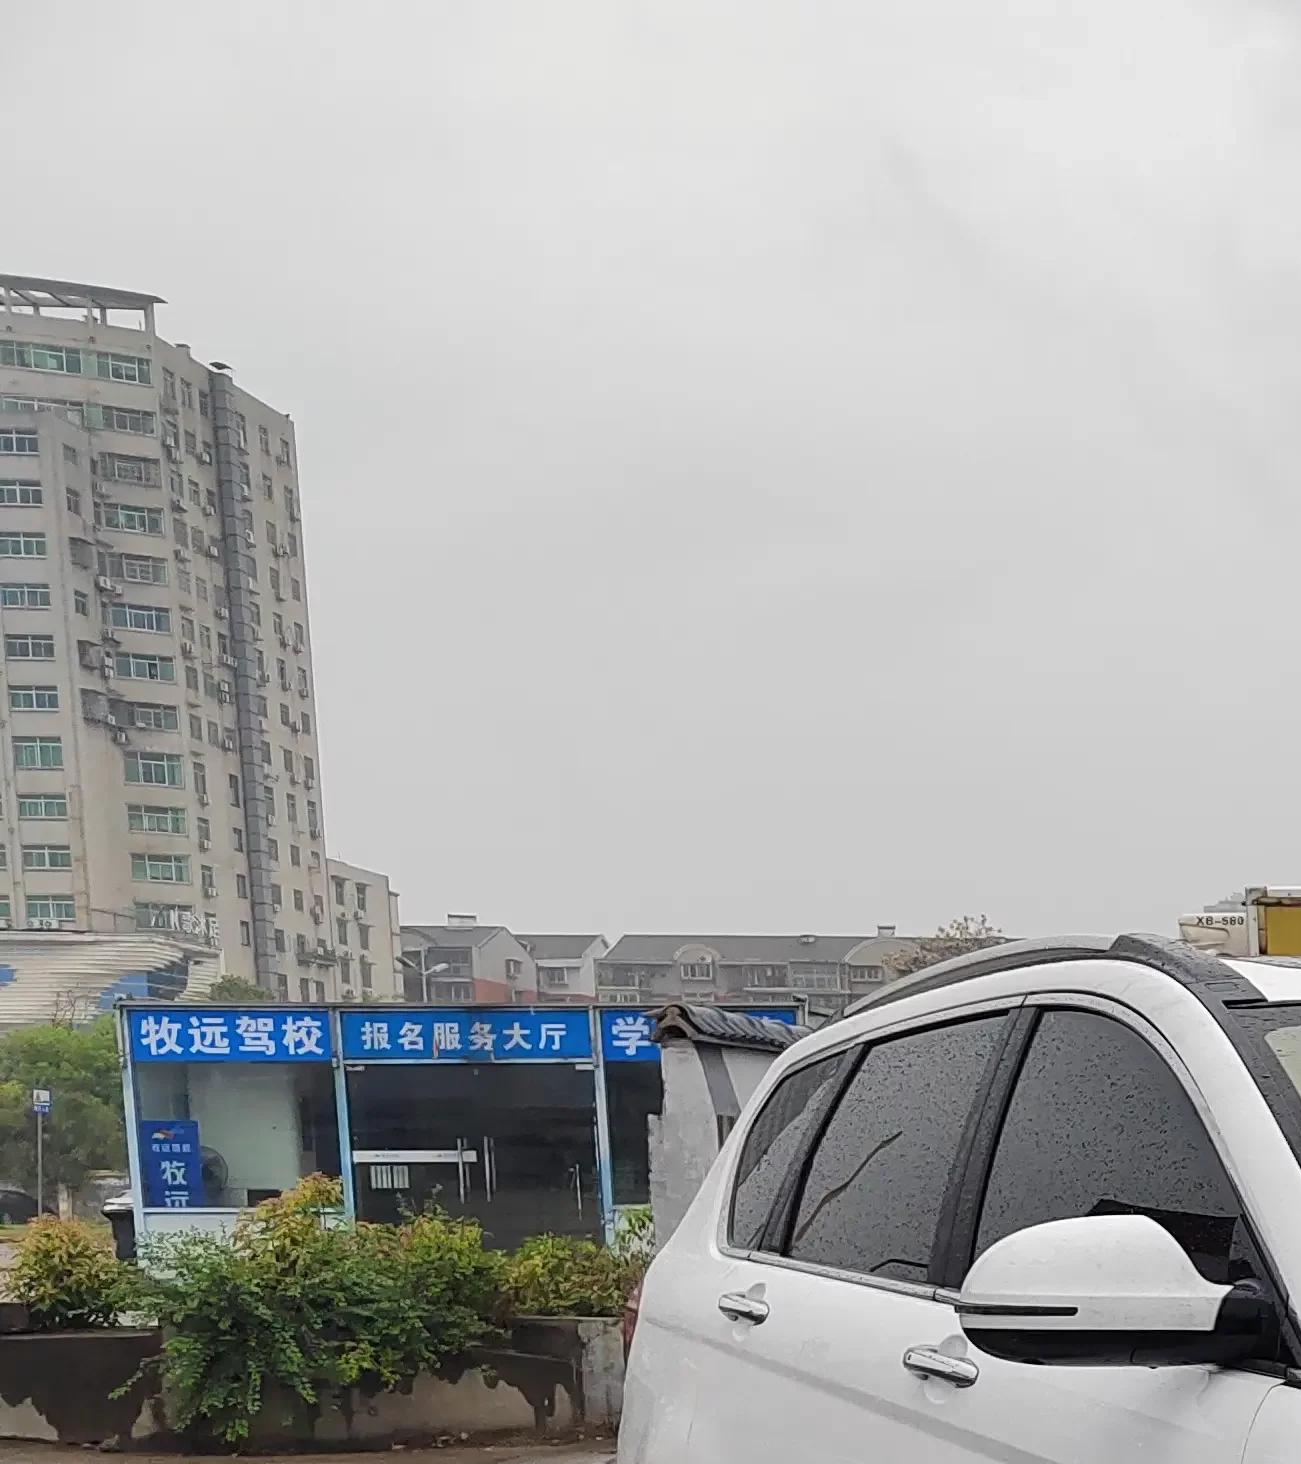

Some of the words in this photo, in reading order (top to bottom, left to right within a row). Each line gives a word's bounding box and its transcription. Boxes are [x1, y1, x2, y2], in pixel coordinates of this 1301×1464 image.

[140, 1015, 325, 1056] 牧远驾校
[360, 1021, 568, 1051] 报名服务大厅
